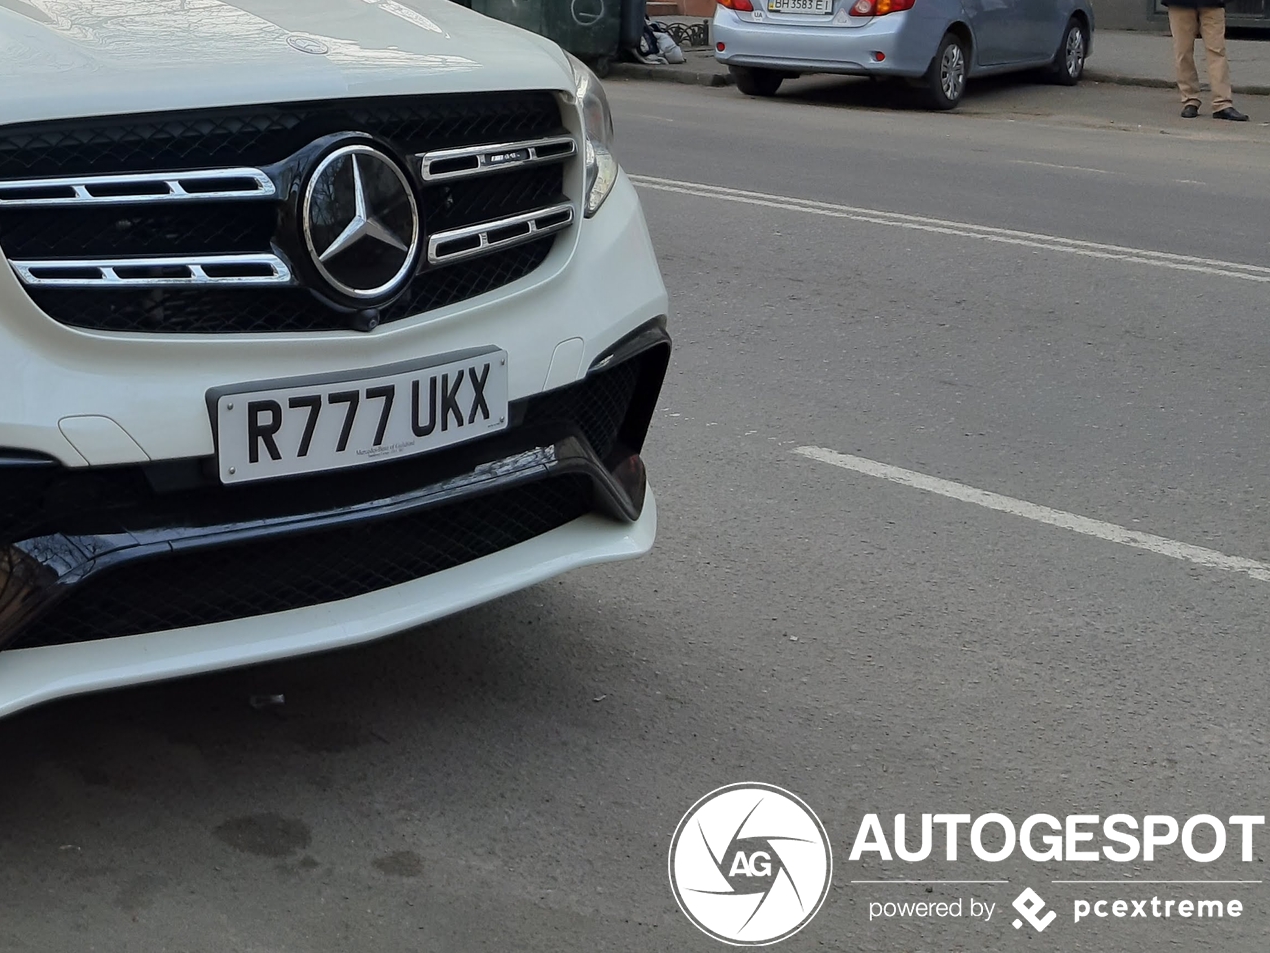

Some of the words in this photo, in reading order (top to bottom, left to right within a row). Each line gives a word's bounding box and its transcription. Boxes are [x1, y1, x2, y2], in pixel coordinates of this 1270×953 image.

[790, 0, 813, 10] 3583
[754, 11, 763, 19] UA
[247, 384, 396, 464] R777
[411, 363, 491, 438] UKX
